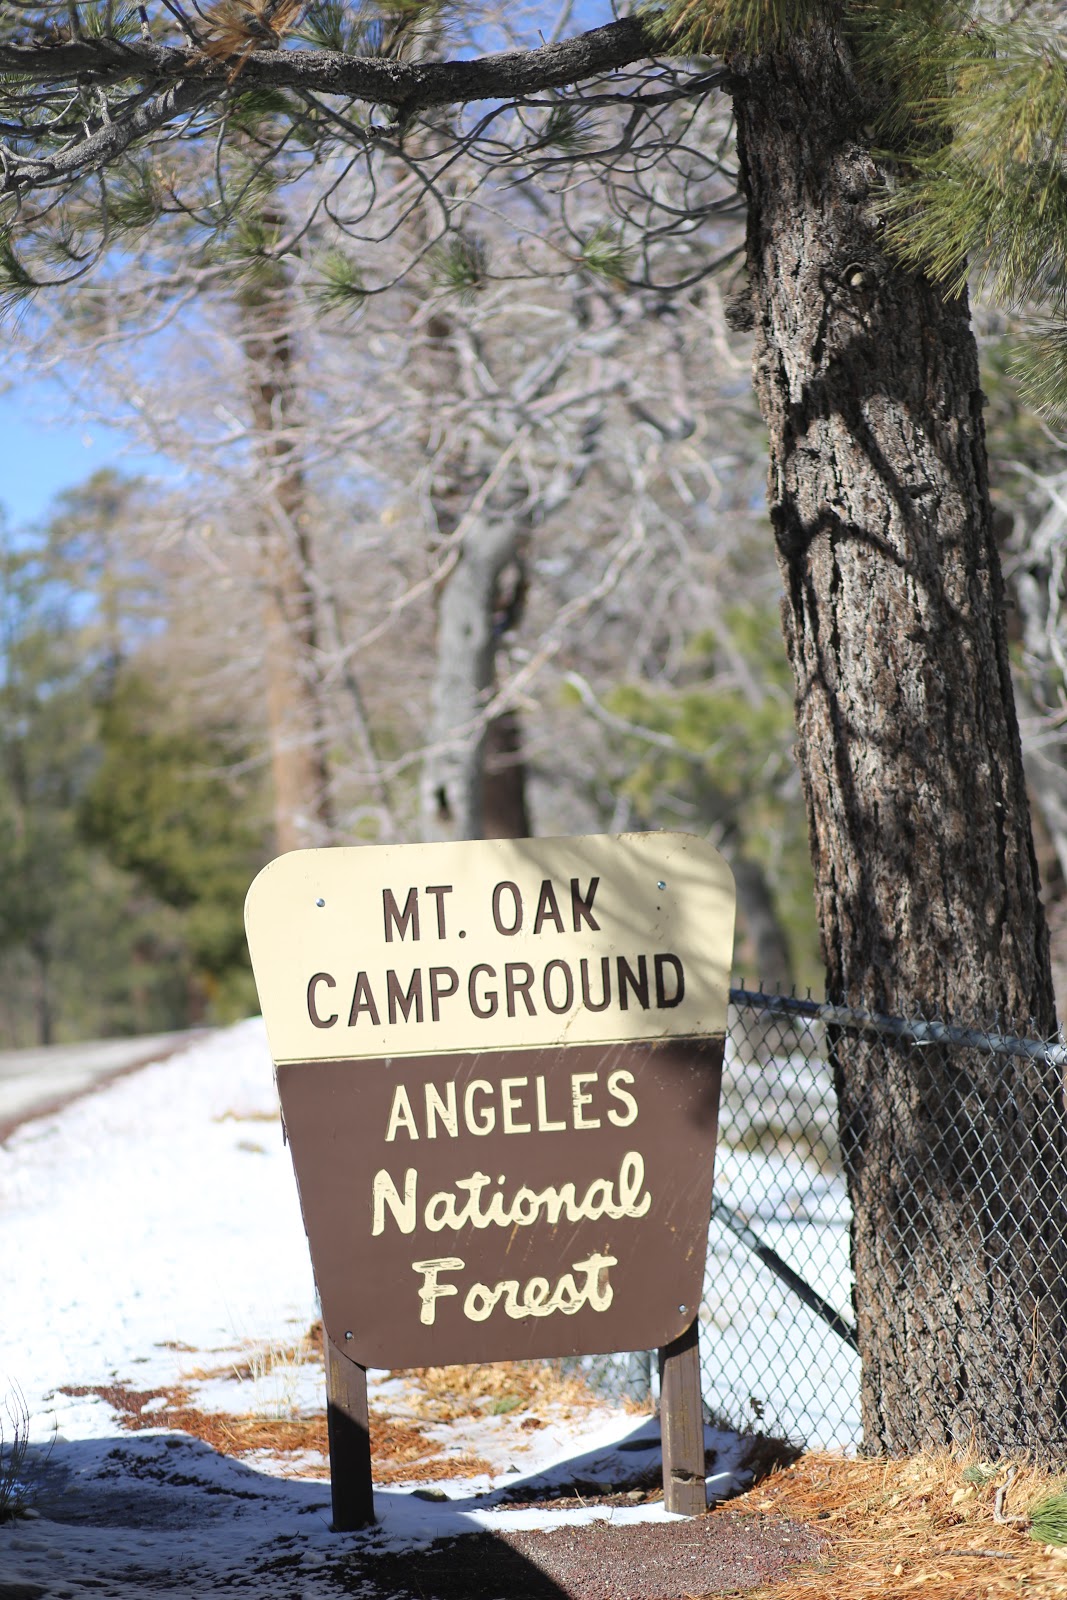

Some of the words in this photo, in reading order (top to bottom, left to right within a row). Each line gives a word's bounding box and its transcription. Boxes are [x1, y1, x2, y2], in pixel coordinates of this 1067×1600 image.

[382, 885, 467, 943] MT.
[492, 877, 601, 937] OAK
[307, 953, 686, 1029] CAMPGROUND
[385, 1069, 639, 1142] ANGELES
[371, 1151, 652, 1236] National
[412, 1253, 618, 1325] Forest
